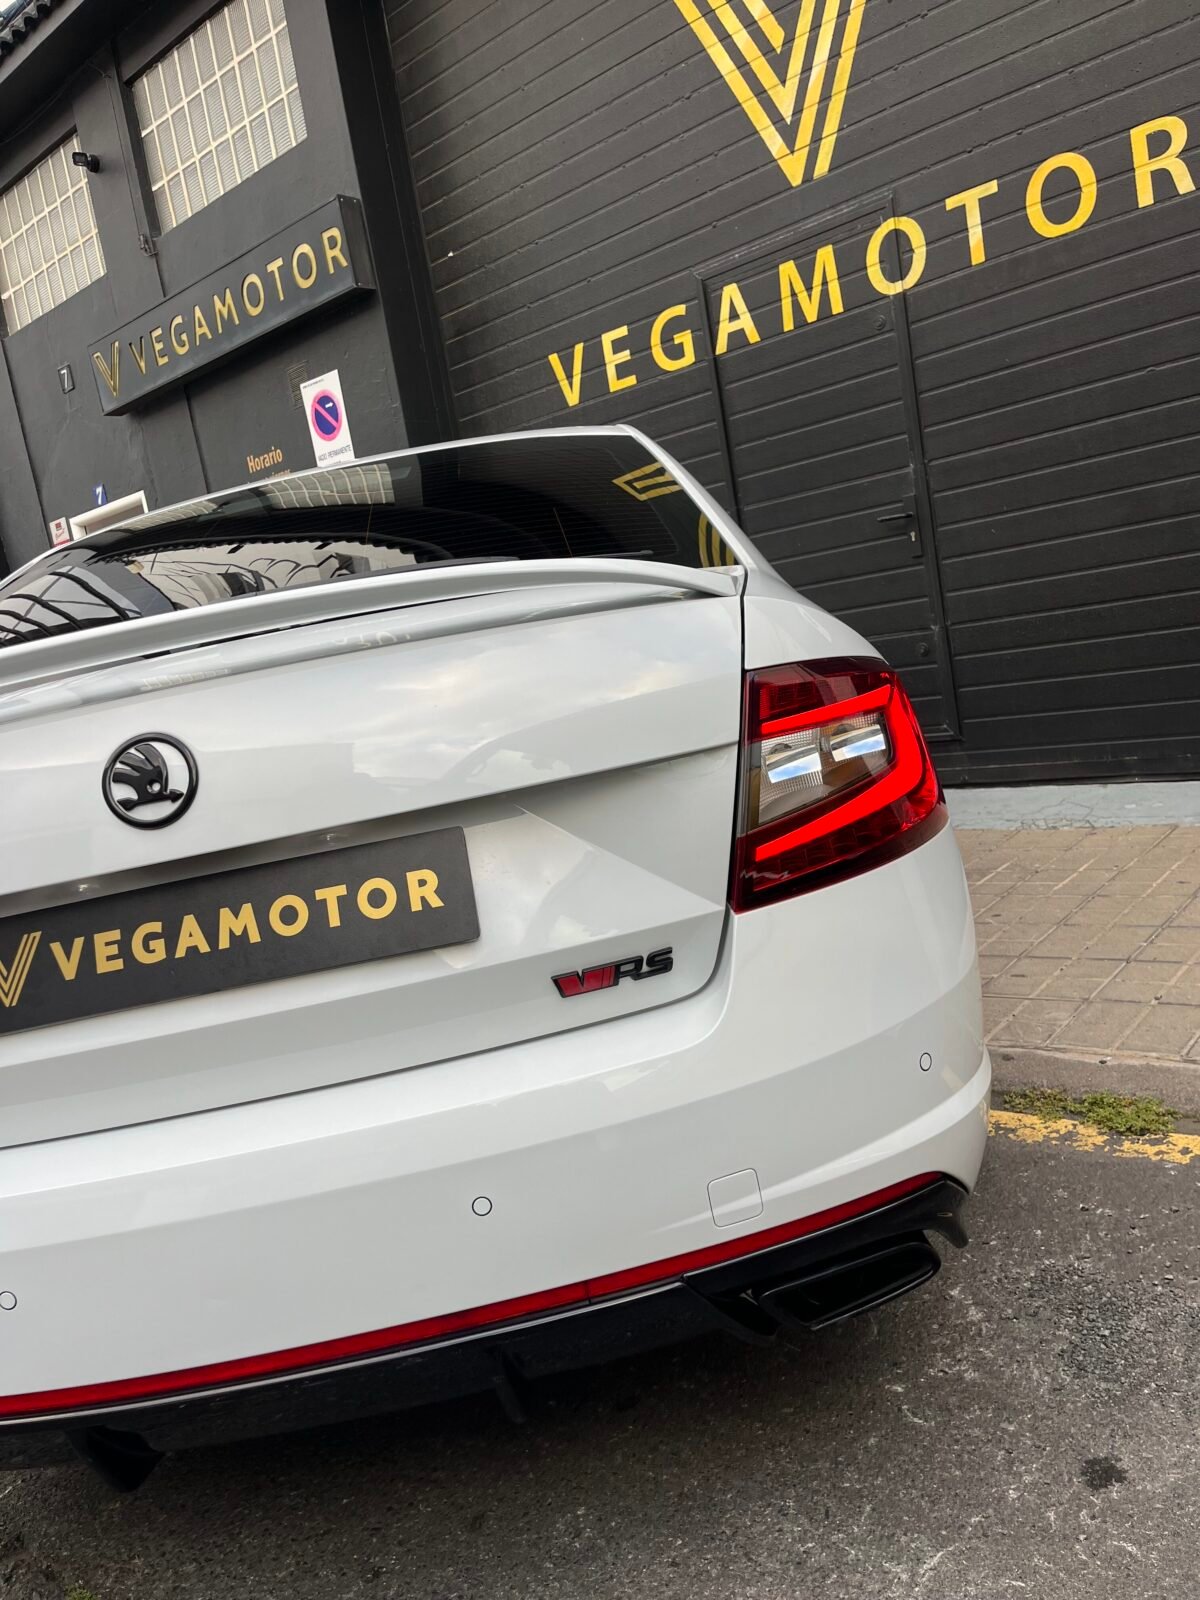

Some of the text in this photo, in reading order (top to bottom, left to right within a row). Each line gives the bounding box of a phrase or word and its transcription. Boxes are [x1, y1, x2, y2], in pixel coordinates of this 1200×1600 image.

[129, 227, 348, 375] VEGAMOTOR
[548, 115, 1196, 407] VEGAMOTOR
[95, 485, 104, 505] 7
[247, 446, 283, 473] Horario
[50, 868, 445, 981] VEGAMOTOR
